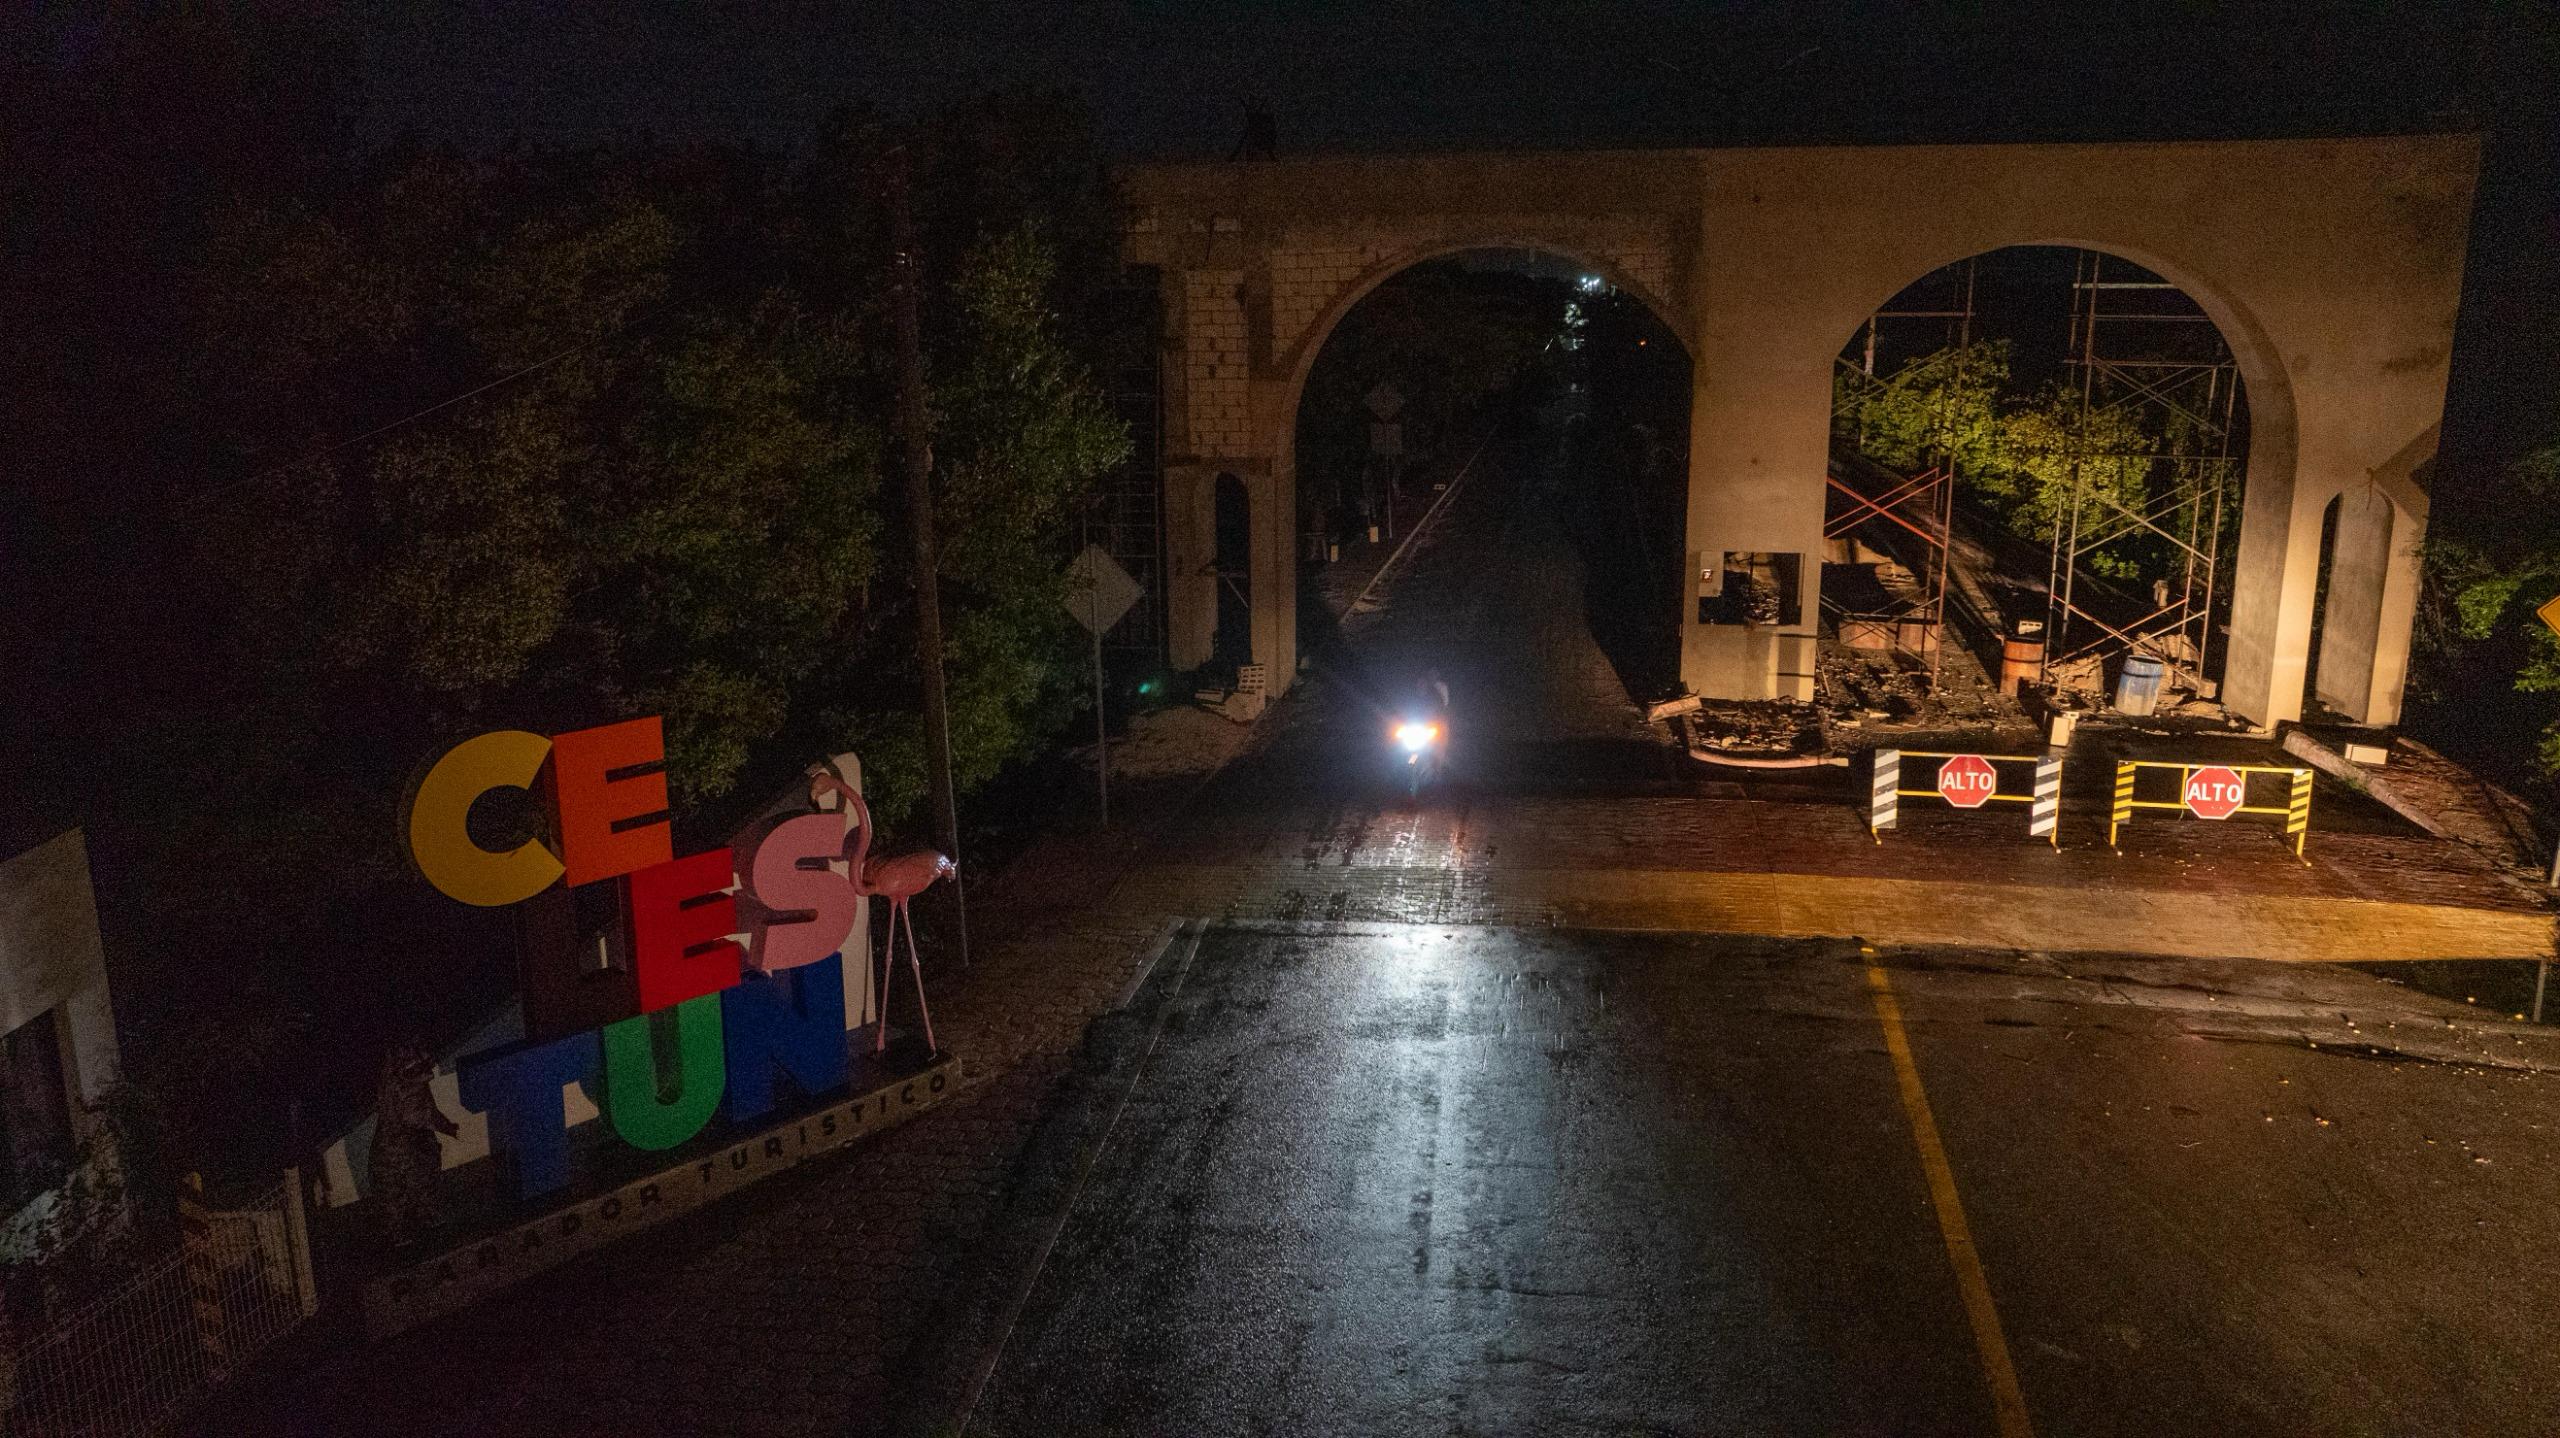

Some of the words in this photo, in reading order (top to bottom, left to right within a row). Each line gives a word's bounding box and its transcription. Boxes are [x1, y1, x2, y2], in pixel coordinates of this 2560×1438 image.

[1942, 771, 1993, 792] ALTO
[2186, 782, 2242, 804] ALTO
[699, 1074, 946, 1183] TURISTICO
